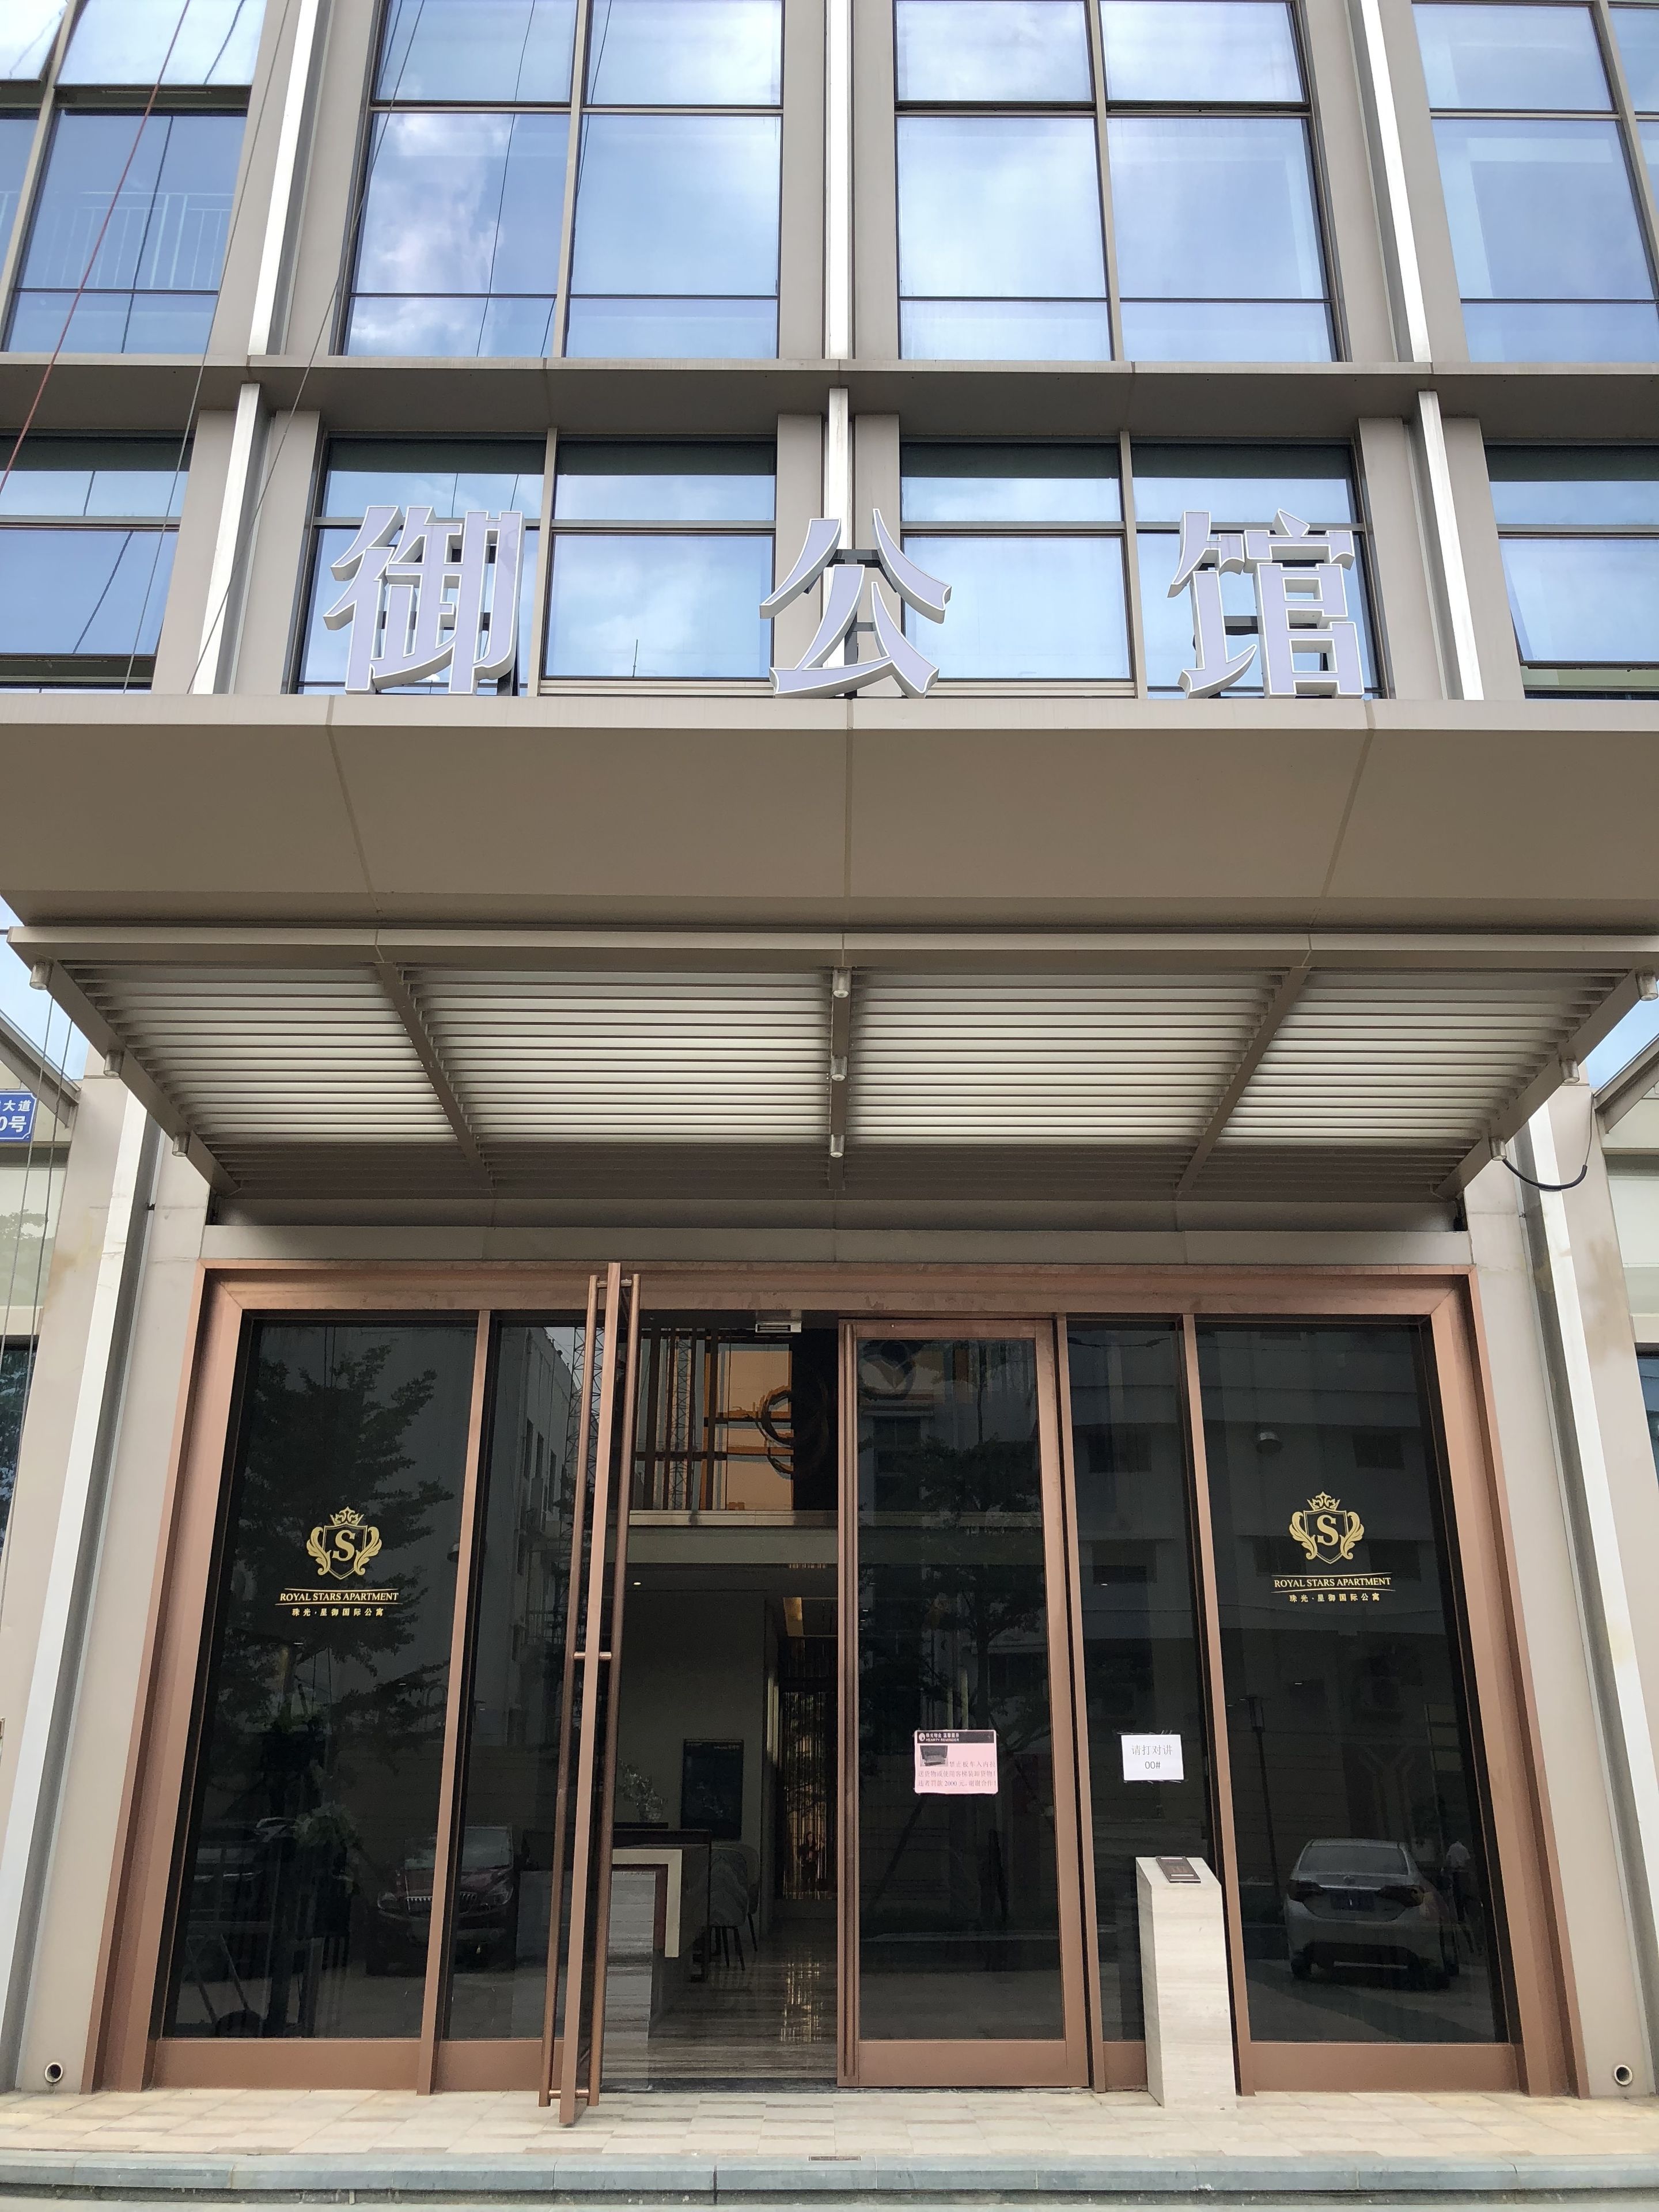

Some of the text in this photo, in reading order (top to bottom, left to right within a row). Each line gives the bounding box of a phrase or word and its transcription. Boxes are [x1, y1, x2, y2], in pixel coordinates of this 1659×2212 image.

[323, 505, 1365, 699] 御公馆
[0, 1100, 31, 1112] 大道
[1317, 1514, 1339, 1546] S
[332, 1529, 356, 1562] S
[1274, 1577, 1391, 1588] ROYAL STARS APARTMENT
[280, 1592, 399, 1601] ROYAL STARS APARTMENT
[1131, 1744, 1173, 1755] 请打对讲
